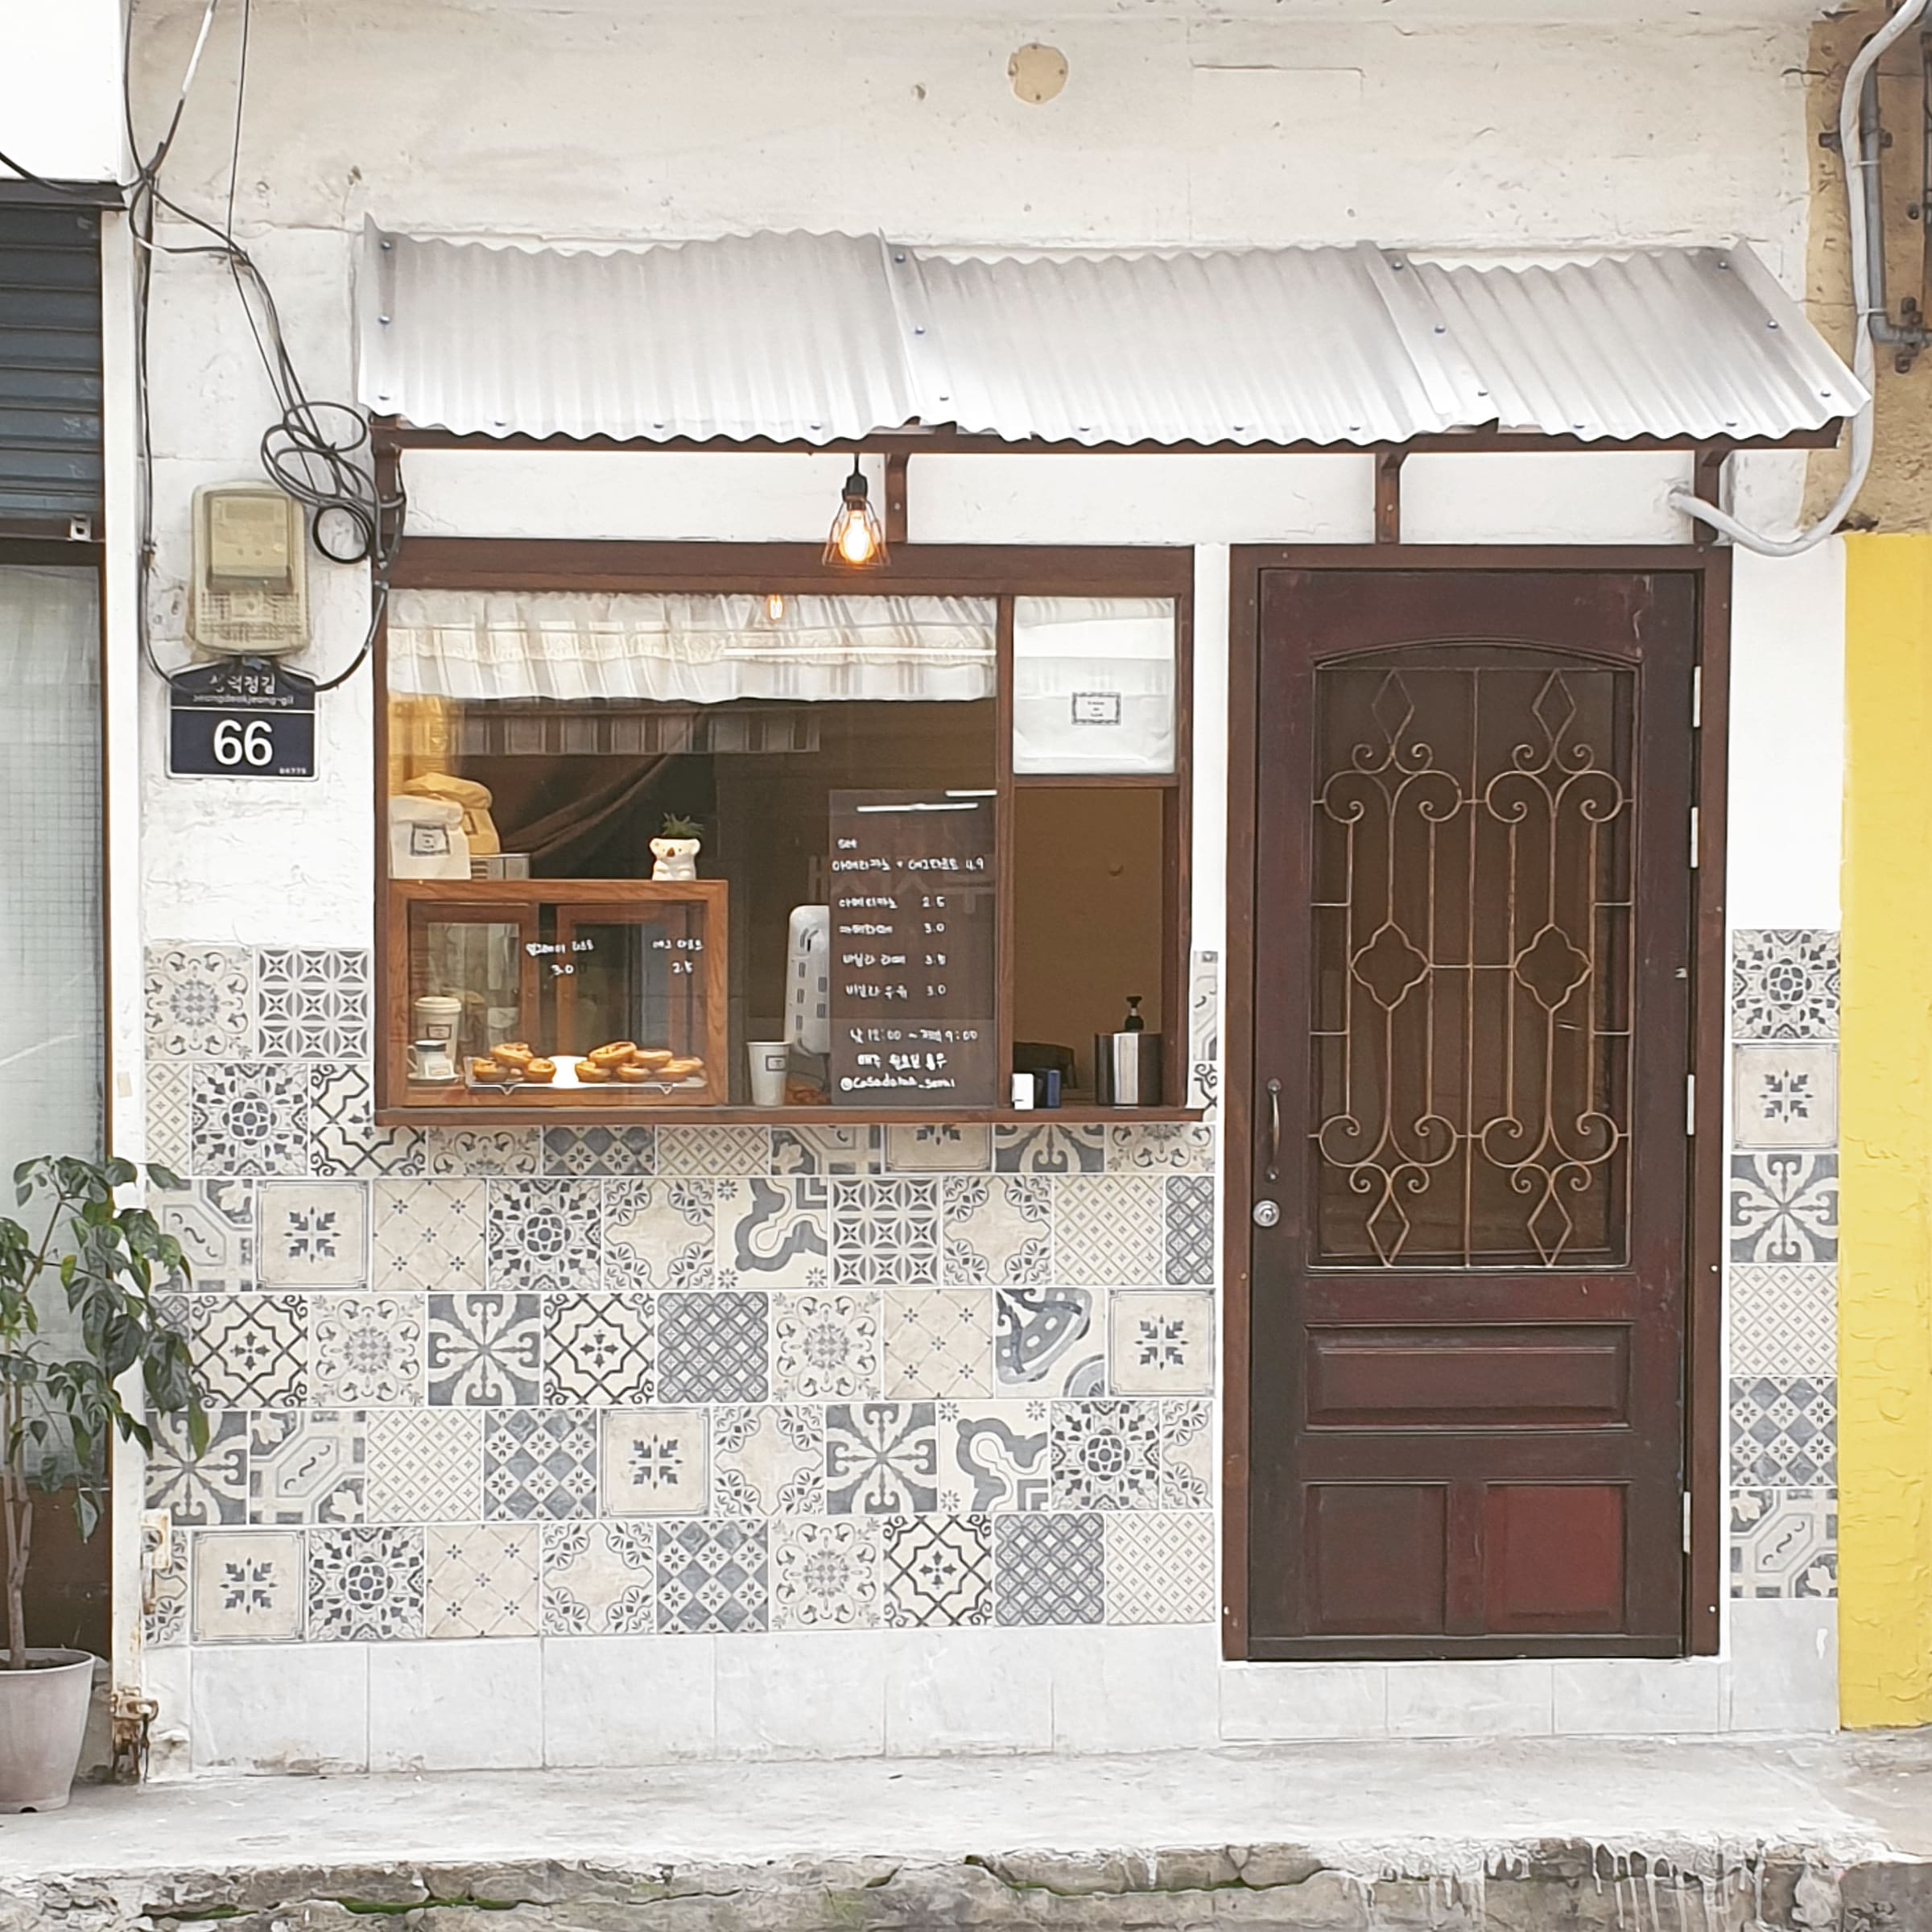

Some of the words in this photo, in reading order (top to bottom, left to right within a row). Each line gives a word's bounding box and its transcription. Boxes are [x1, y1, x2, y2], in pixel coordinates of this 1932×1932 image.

[213, 719, 273, 766] 66
[924, 923, 945, 934] 3.0
[927, 985, 946, 996] 3.0
[944, 1030, 978, 1043] 9:00
